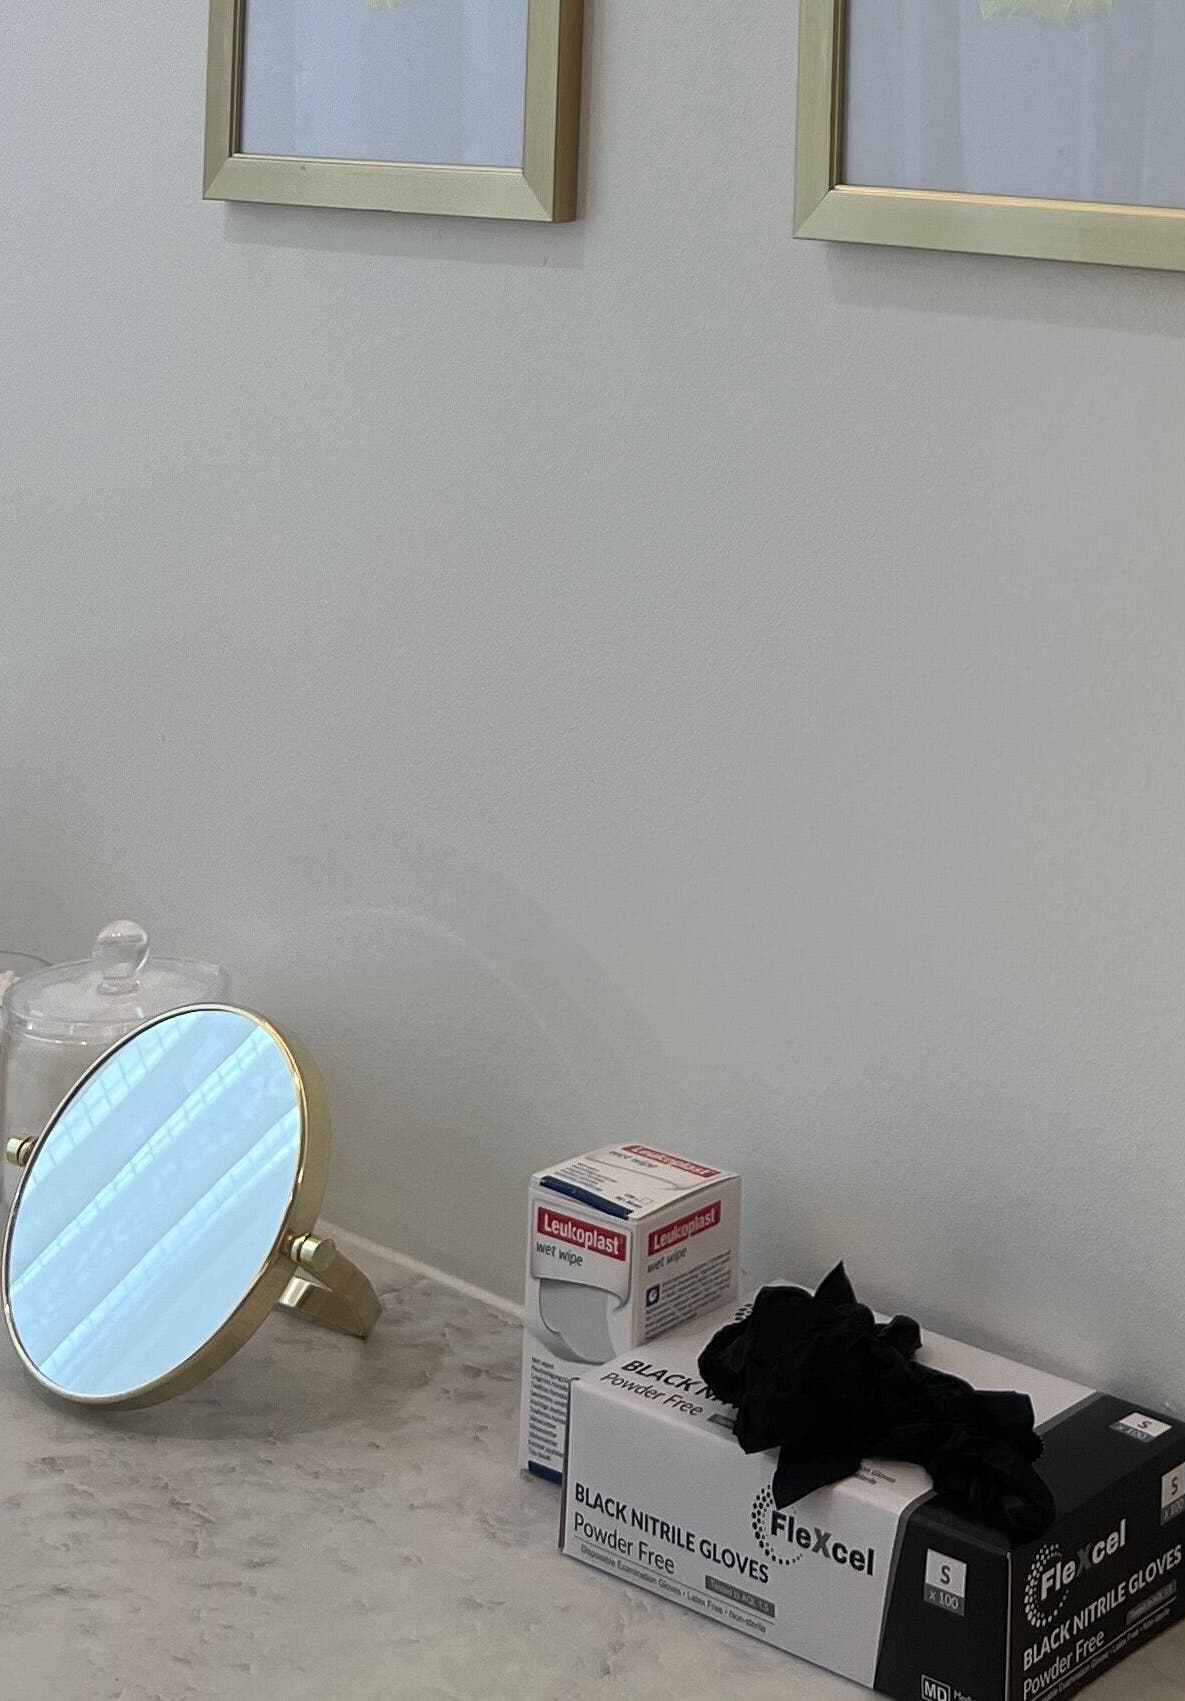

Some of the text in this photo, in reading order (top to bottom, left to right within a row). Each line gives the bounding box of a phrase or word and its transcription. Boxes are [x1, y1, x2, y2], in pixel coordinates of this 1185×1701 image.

[543, 1212, 619, 1255] Leukoplast
[653, 1207, 716, 1251] Leukoplast
[536, 1242, 584, 1267] wet wipe
[600, 1372, 666, 1400] Powder
[663, 1394, 704, 1416] Free
[621, 1360, 702, 1391] BLACK
[1136, 1420, 1153, 1430] S
[1170, 1476, 1179, 1496] S
[574, 1511, 675, 1575] Powder Free
[575, 1482, 769, 1583] BLACK NITRILE GLOVES
[770, 1510, 875, 1576] FleXcel
[940, 1564, 951, 1585] S
[939, 1592, 959, 1609] 100
[1023, 1618, 1071, 1671] BLACK
[1073, 1581, 1127, 1636] NITRILE
[1127, 1545, 1182, 1594] GLOVES
[1023, 1630, 1105, 1701] Powder Free
[924, 1680, 948, 1701] MD
